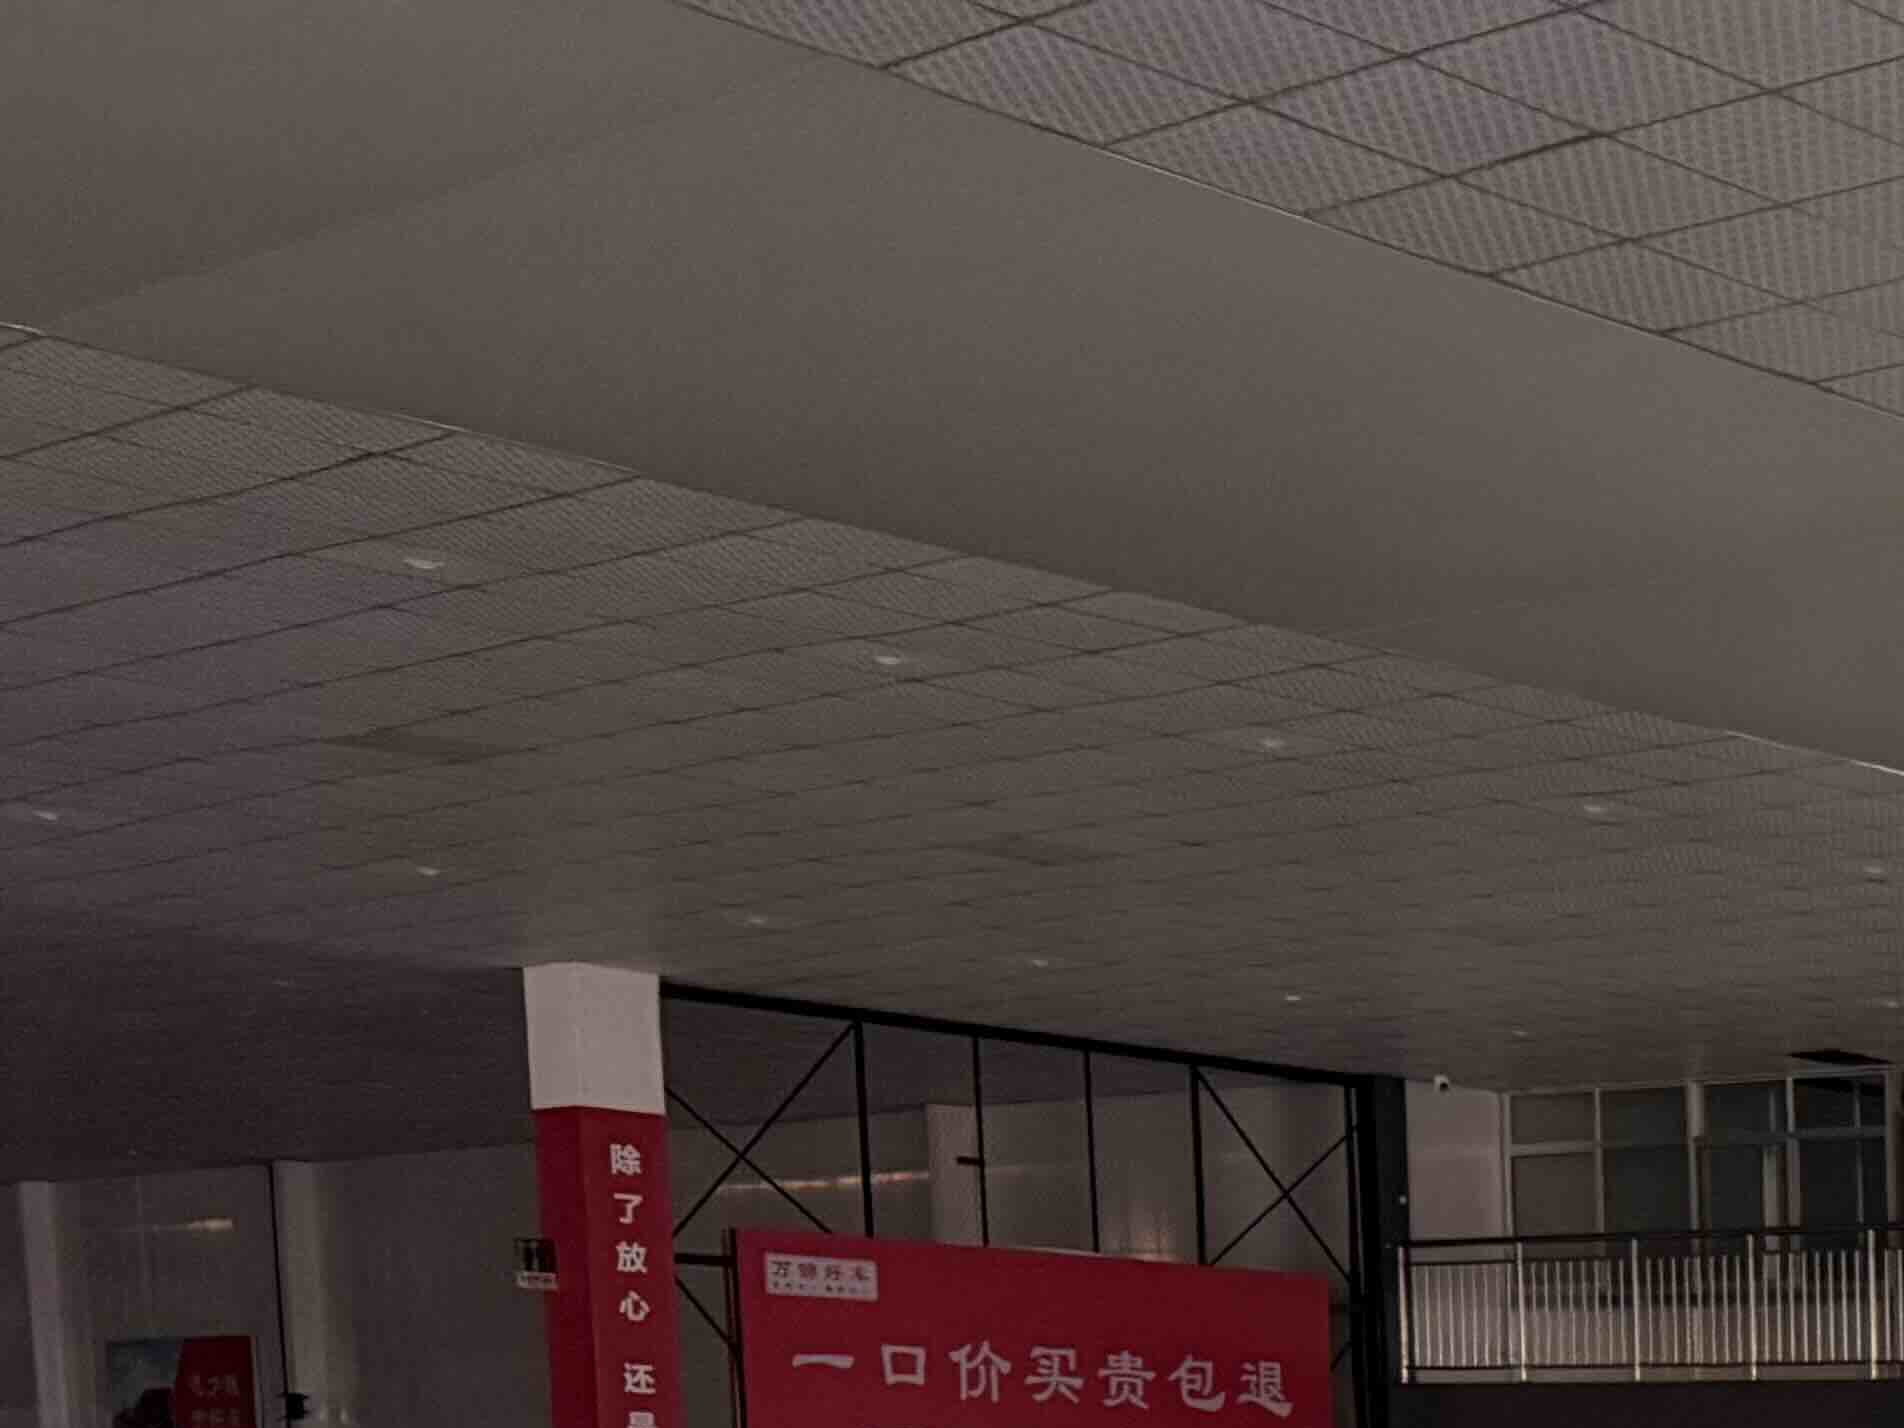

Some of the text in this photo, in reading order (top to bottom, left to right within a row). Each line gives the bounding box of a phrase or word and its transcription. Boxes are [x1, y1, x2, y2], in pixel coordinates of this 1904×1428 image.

[609, 1143, 650, 1322] 除了放心
[792, 1340, 1294, 1418] 一口价买贵包退
